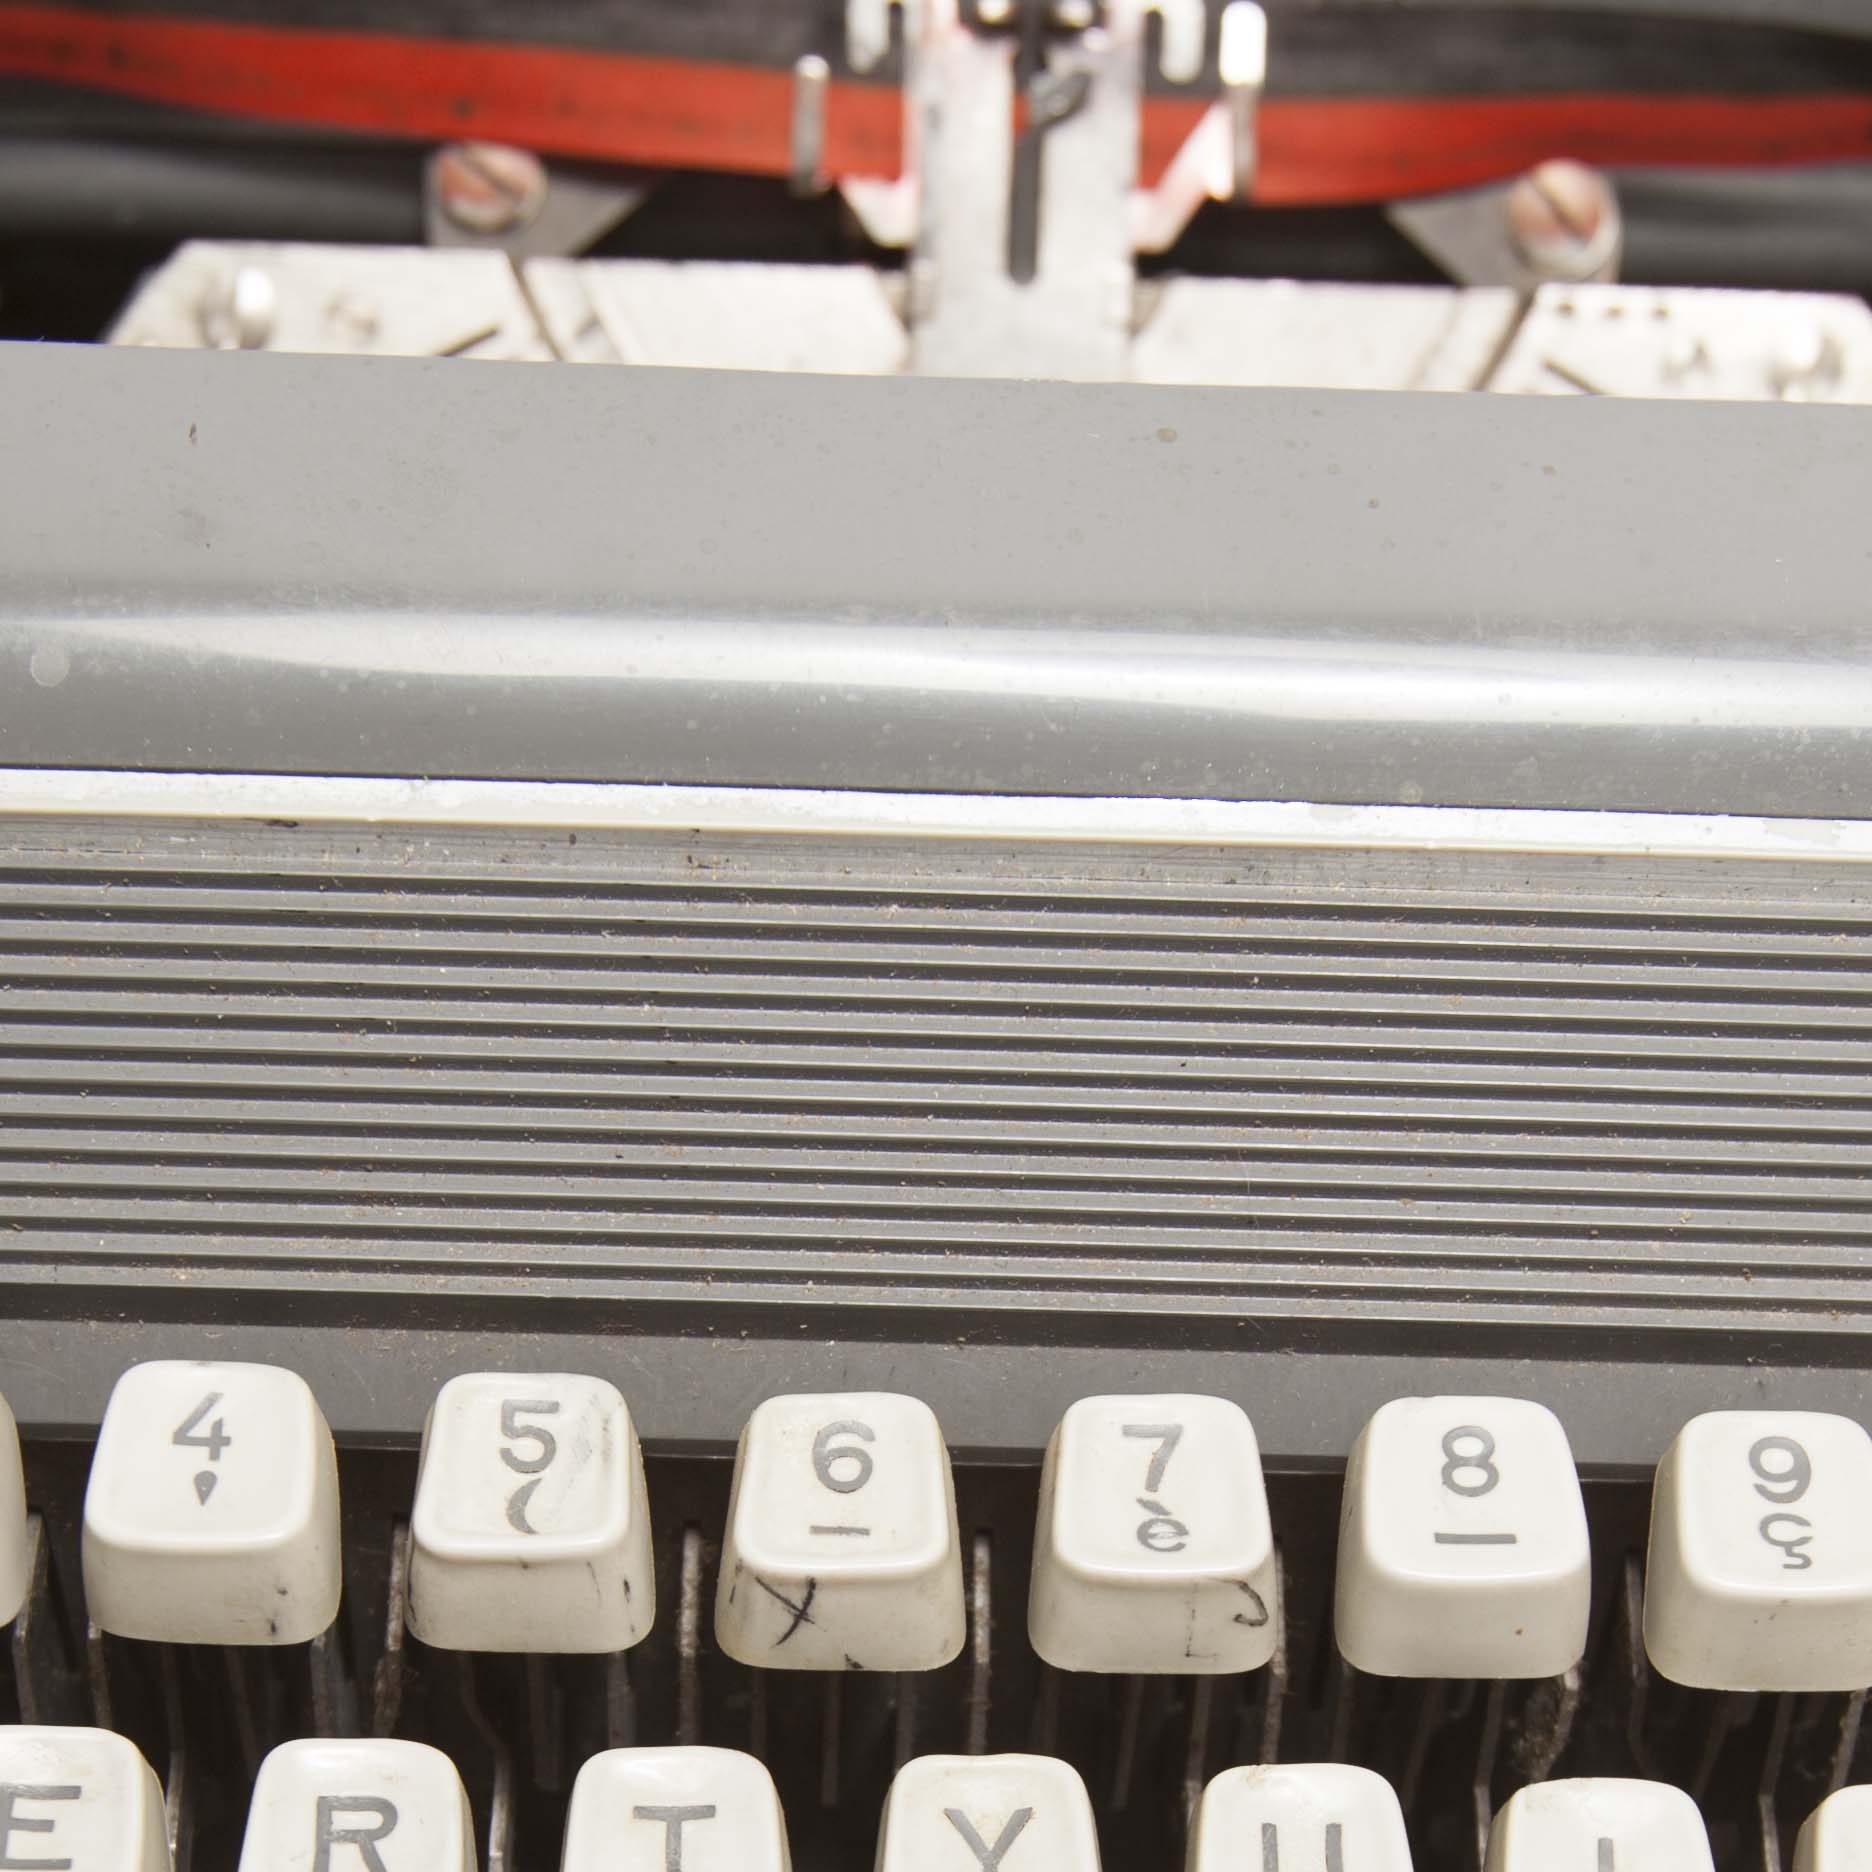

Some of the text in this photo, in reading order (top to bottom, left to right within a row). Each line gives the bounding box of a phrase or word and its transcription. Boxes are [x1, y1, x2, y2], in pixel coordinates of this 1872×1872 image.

[170, 1391, 234, 1462] 4
[498, 1398, 562, 1476] 5
[810, 1419, 877, 1496] 6
[1120, 1422, 1185, 1495] 7
[1439, 1424, 1501, 1499] 8
[1746, 1434, 1814, 1506] 9
